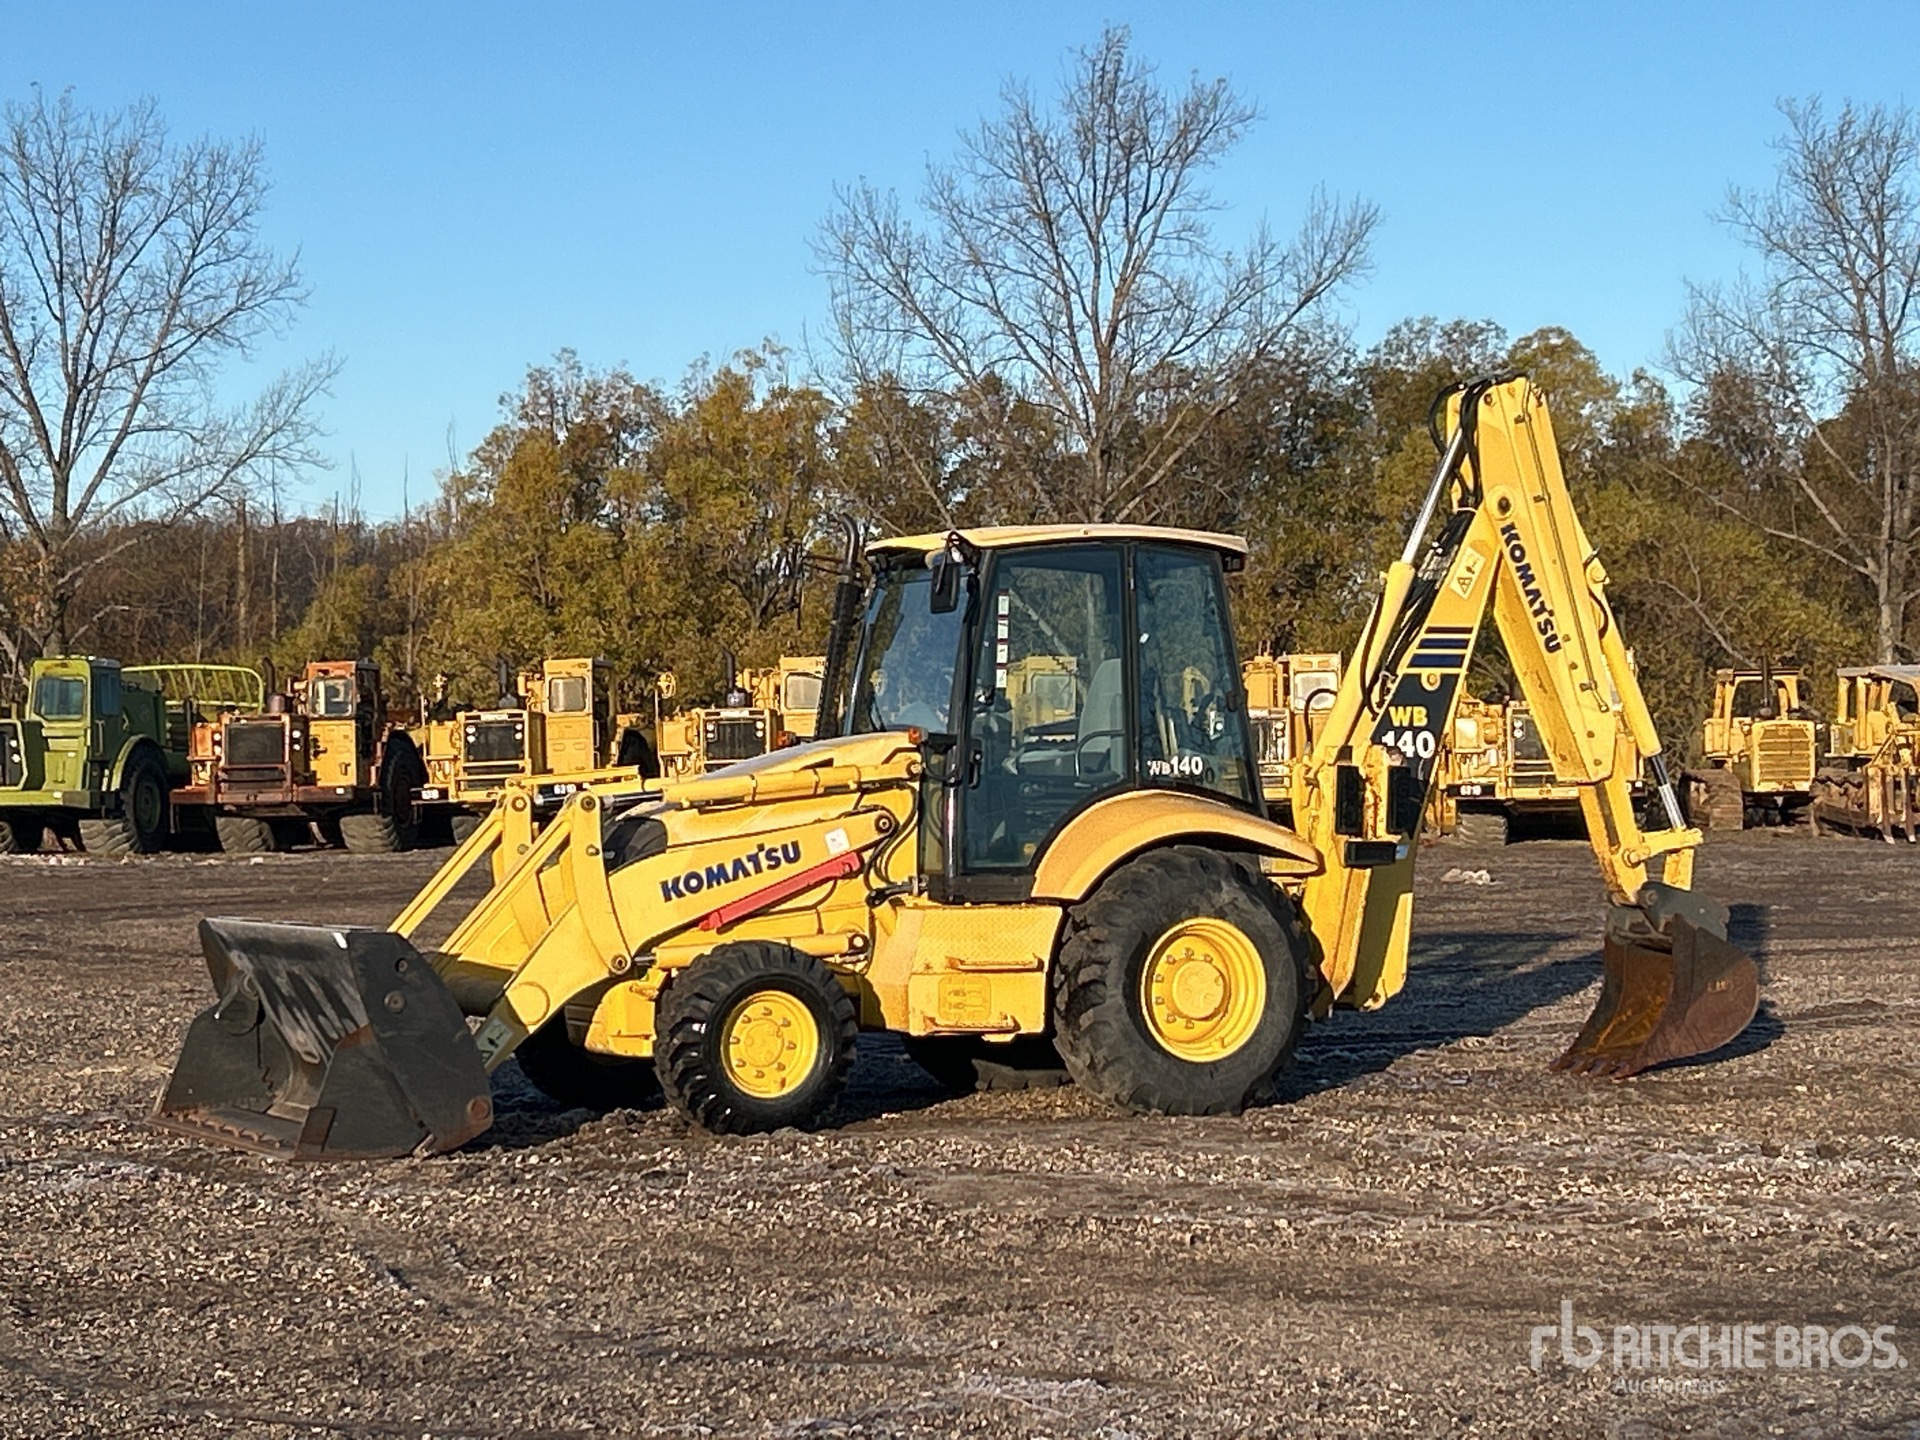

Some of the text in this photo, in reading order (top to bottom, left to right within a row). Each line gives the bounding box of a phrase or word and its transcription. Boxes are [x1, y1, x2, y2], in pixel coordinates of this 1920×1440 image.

[1500, 521, 1562, 653] KOMATSU
[1388, 705, 1428, 727] WB
[1381, 730, 1436, 759] 140
[659, 840, 802, 903] KOMATSU
